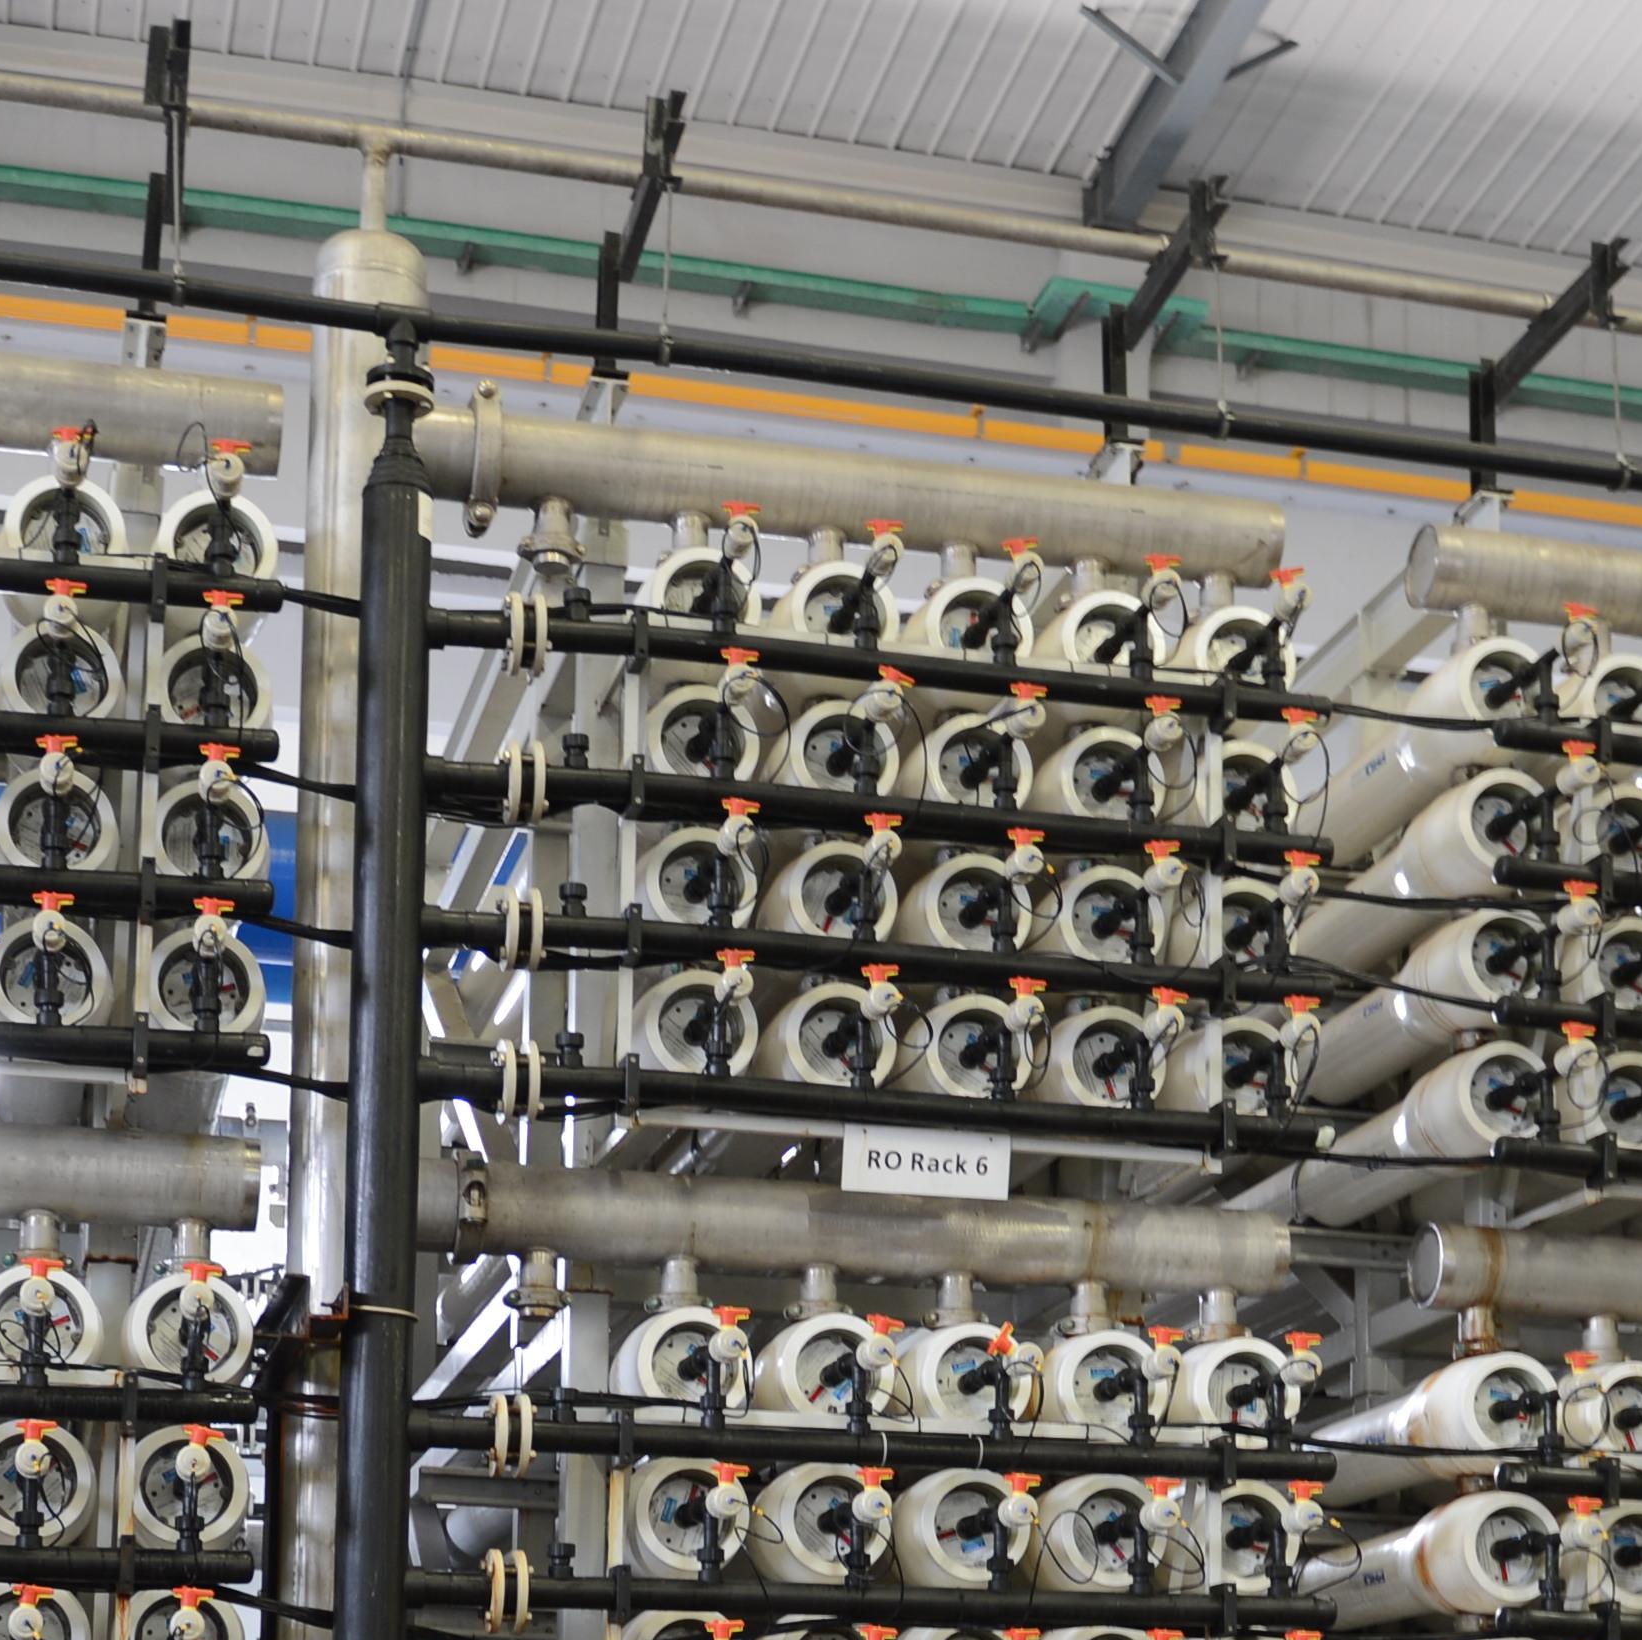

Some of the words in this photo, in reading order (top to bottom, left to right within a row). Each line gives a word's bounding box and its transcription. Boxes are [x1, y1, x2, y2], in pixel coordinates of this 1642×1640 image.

[867, 1149, 903, 1171] RO
[910, 1152, 968, 1176] Rack
[975, 1156, 989, 1176] 6
